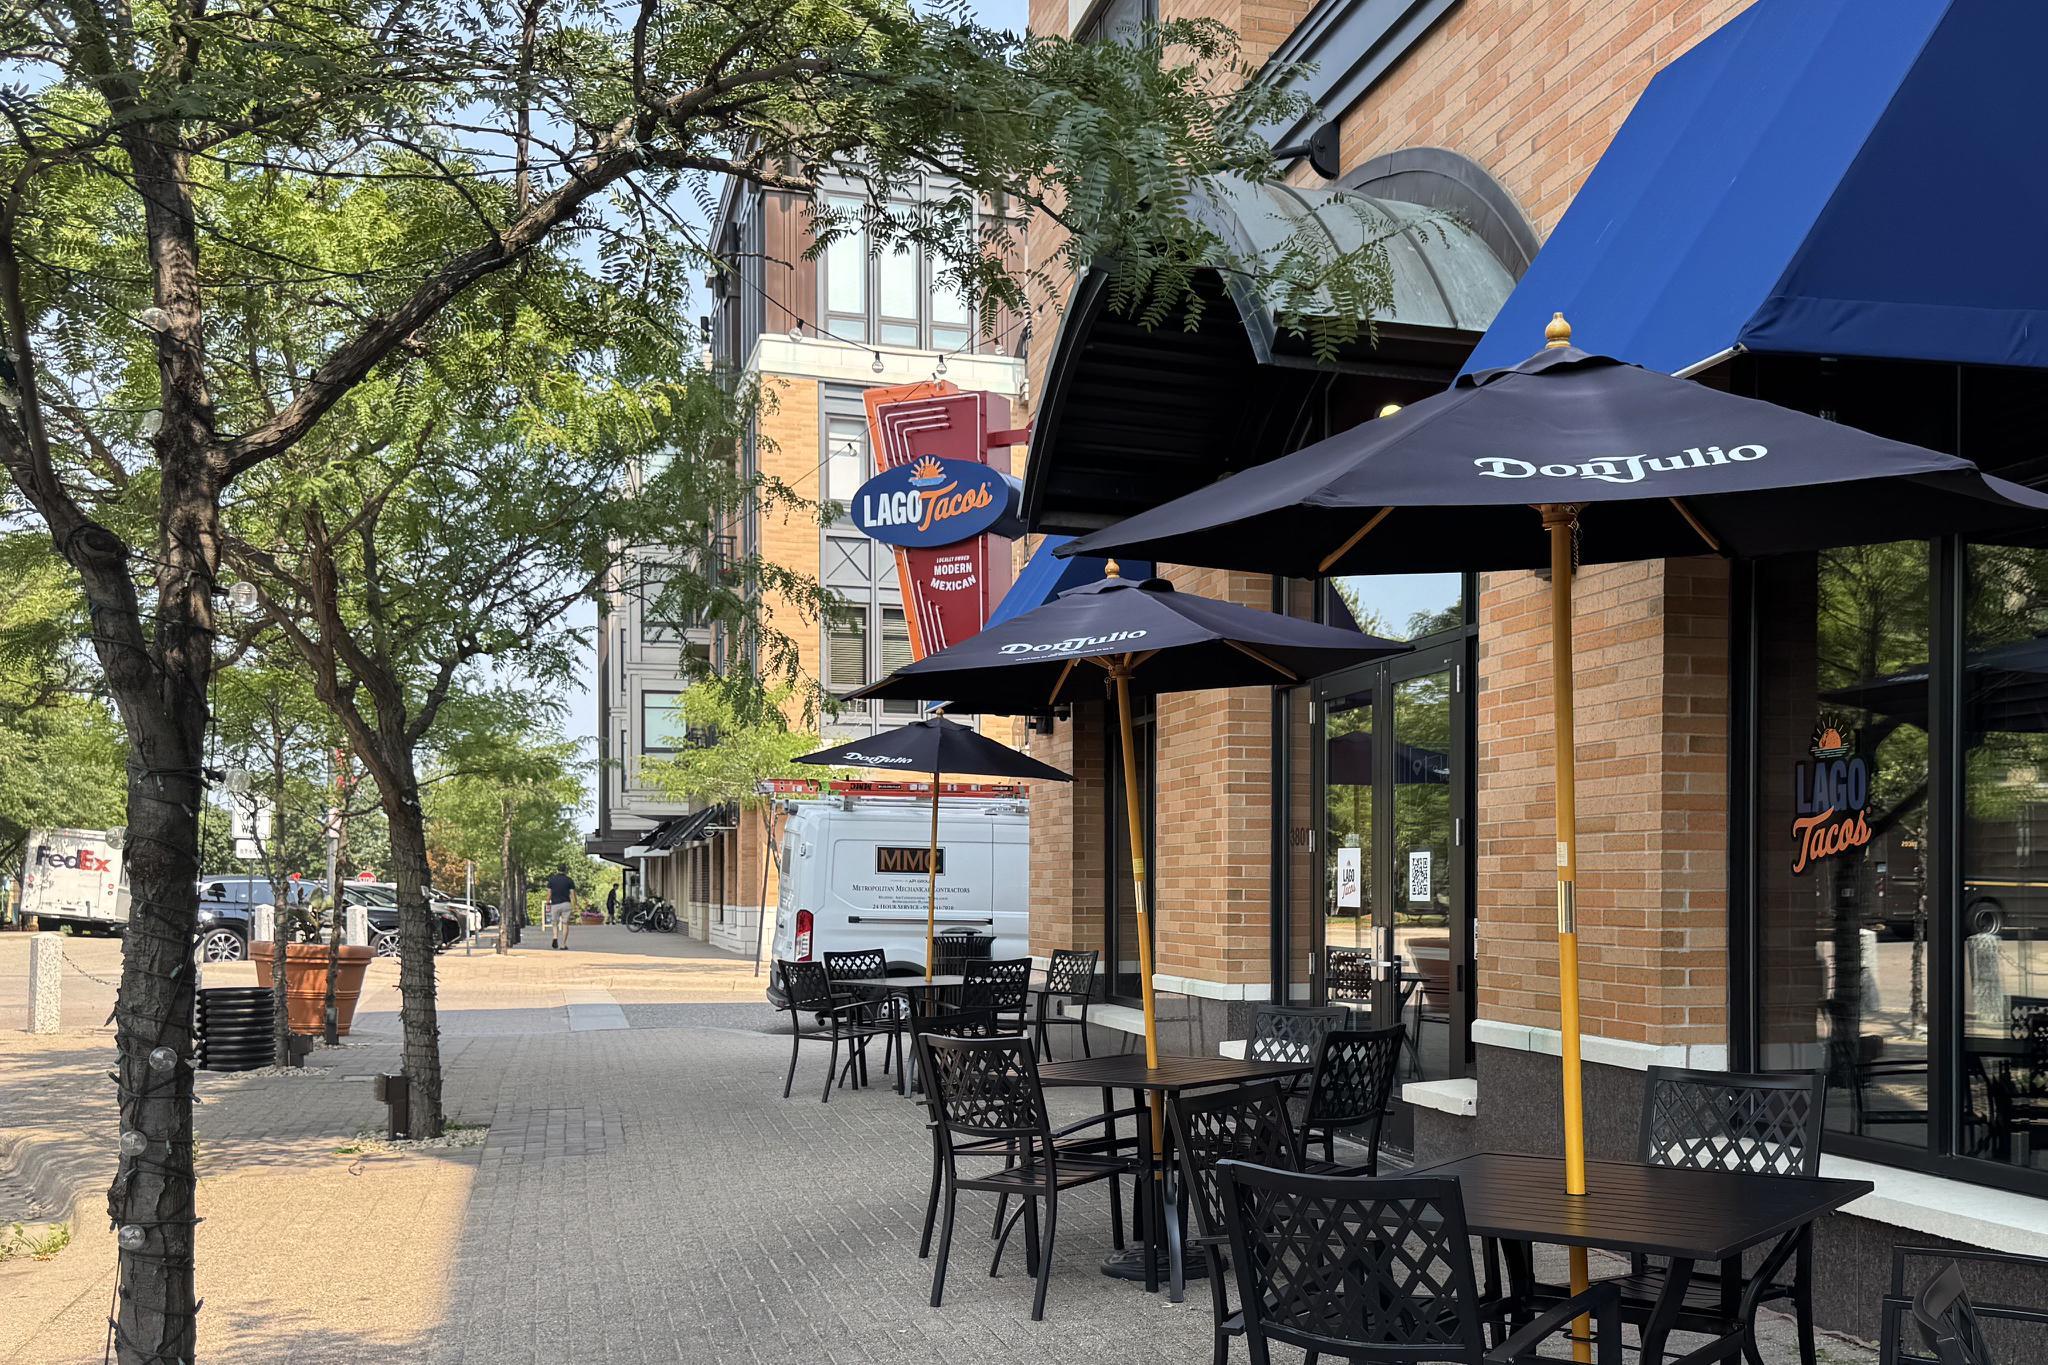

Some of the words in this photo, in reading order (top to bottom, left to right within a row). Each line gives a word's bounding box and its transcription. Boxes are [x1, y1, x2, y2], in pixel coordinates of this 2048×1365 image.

[863, 490, 922, 528] LAGO
[917, 480, 993, 532] Tacos
[930, 574, 977, 591] MEXICAN
[933, 562, 972, 576] MODERN
[1796, 758, 1867, 814] LAGO
[1793, 806, 1872, 873] Tacos
[35, 845, 112, 873] FedEx
[1342, 868, 1355, 882] LAGO
